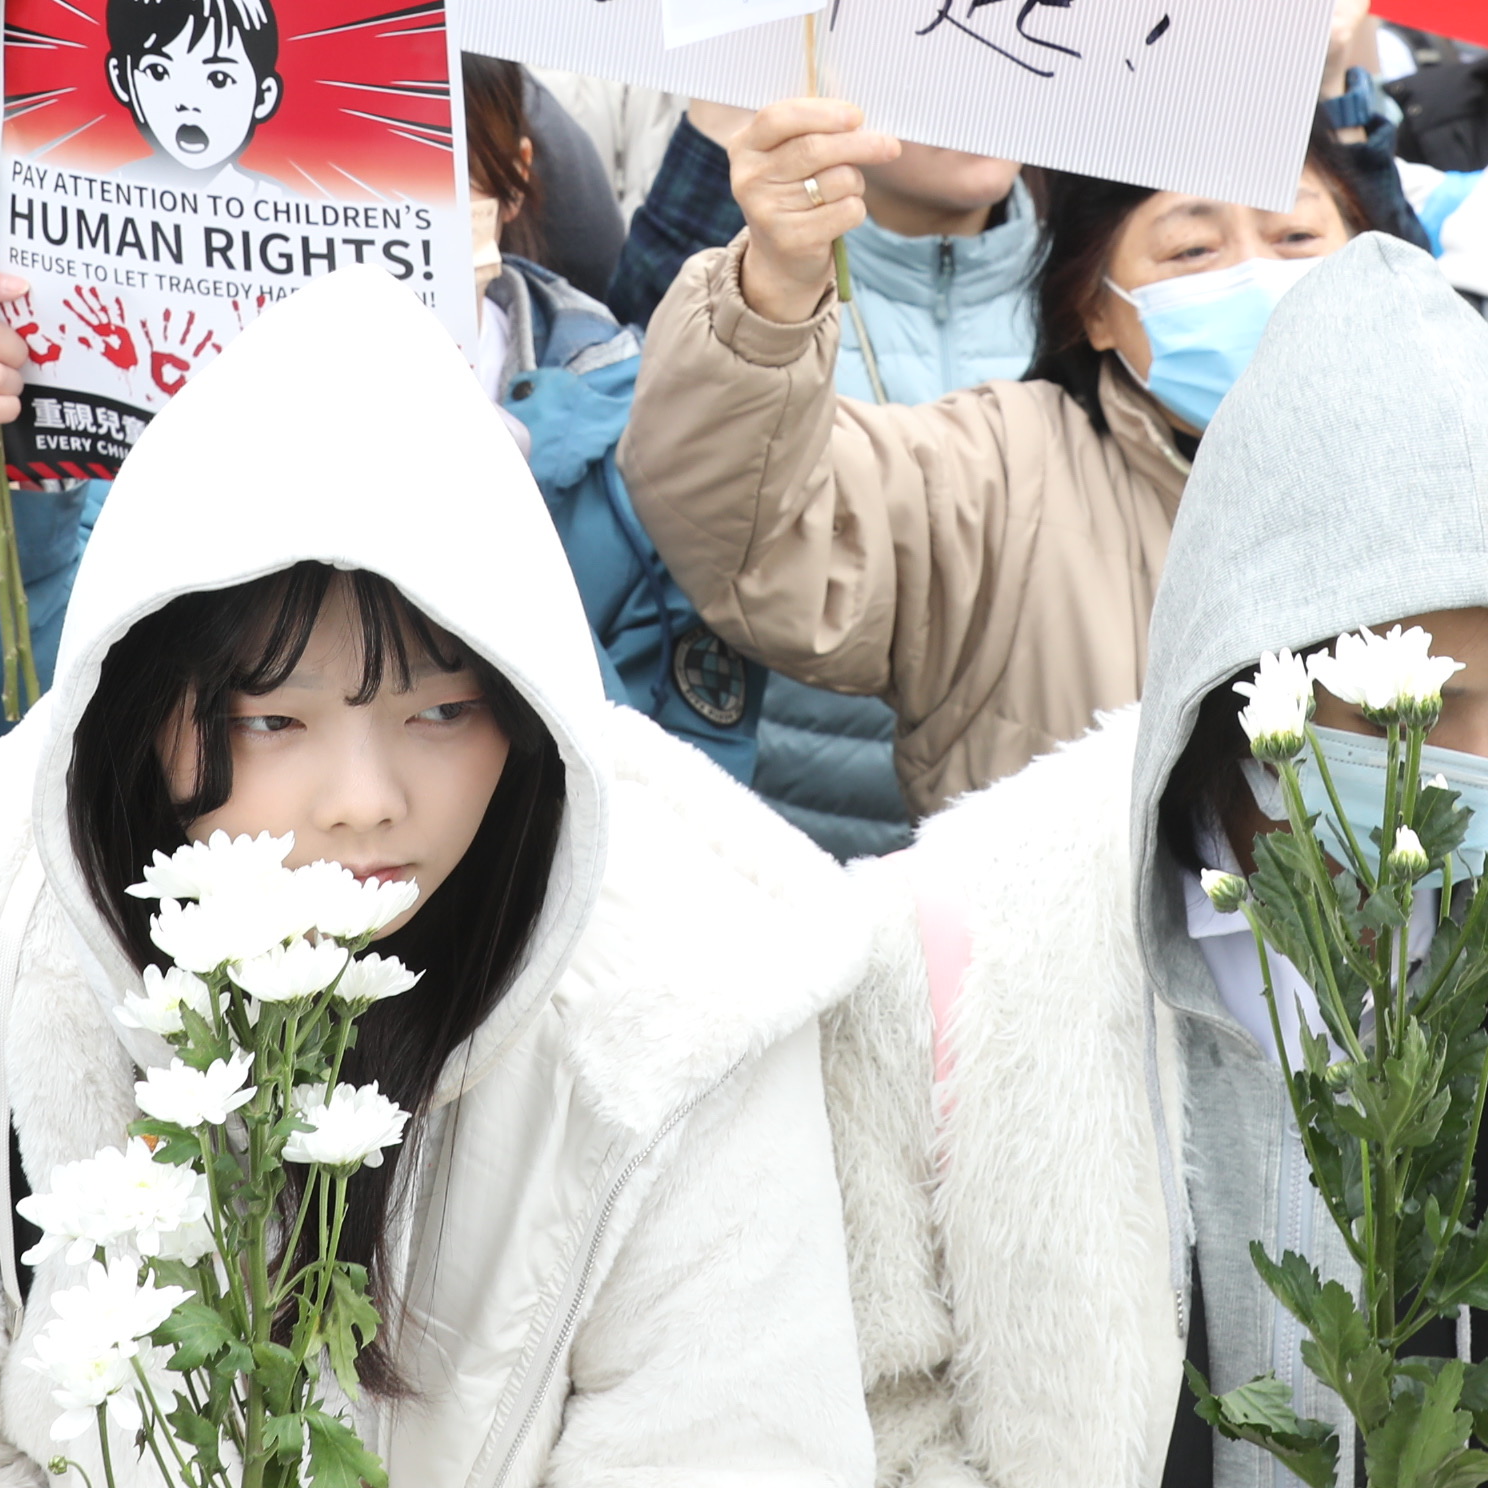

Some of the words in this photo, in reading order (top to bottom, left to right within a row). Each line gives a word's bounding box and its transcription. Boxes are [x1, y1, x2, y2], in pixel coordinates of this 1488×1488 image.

[11, 160, 48, 191] PAY
[53, 172, 199, 215] ATTENTION
[207, 194, 245, 219] TO
[9, 192, 185, 265] HUMAN
[203, 225, 435, 282] RIGHTS!
[9, 246, 77, 278] REFUSE
[81, 262, 108, 283] TO
[113, 267, 149, 290] LET
[154, 273, 253, 301] TRAGEDY
[35, 434, 93, 453] EVERY
